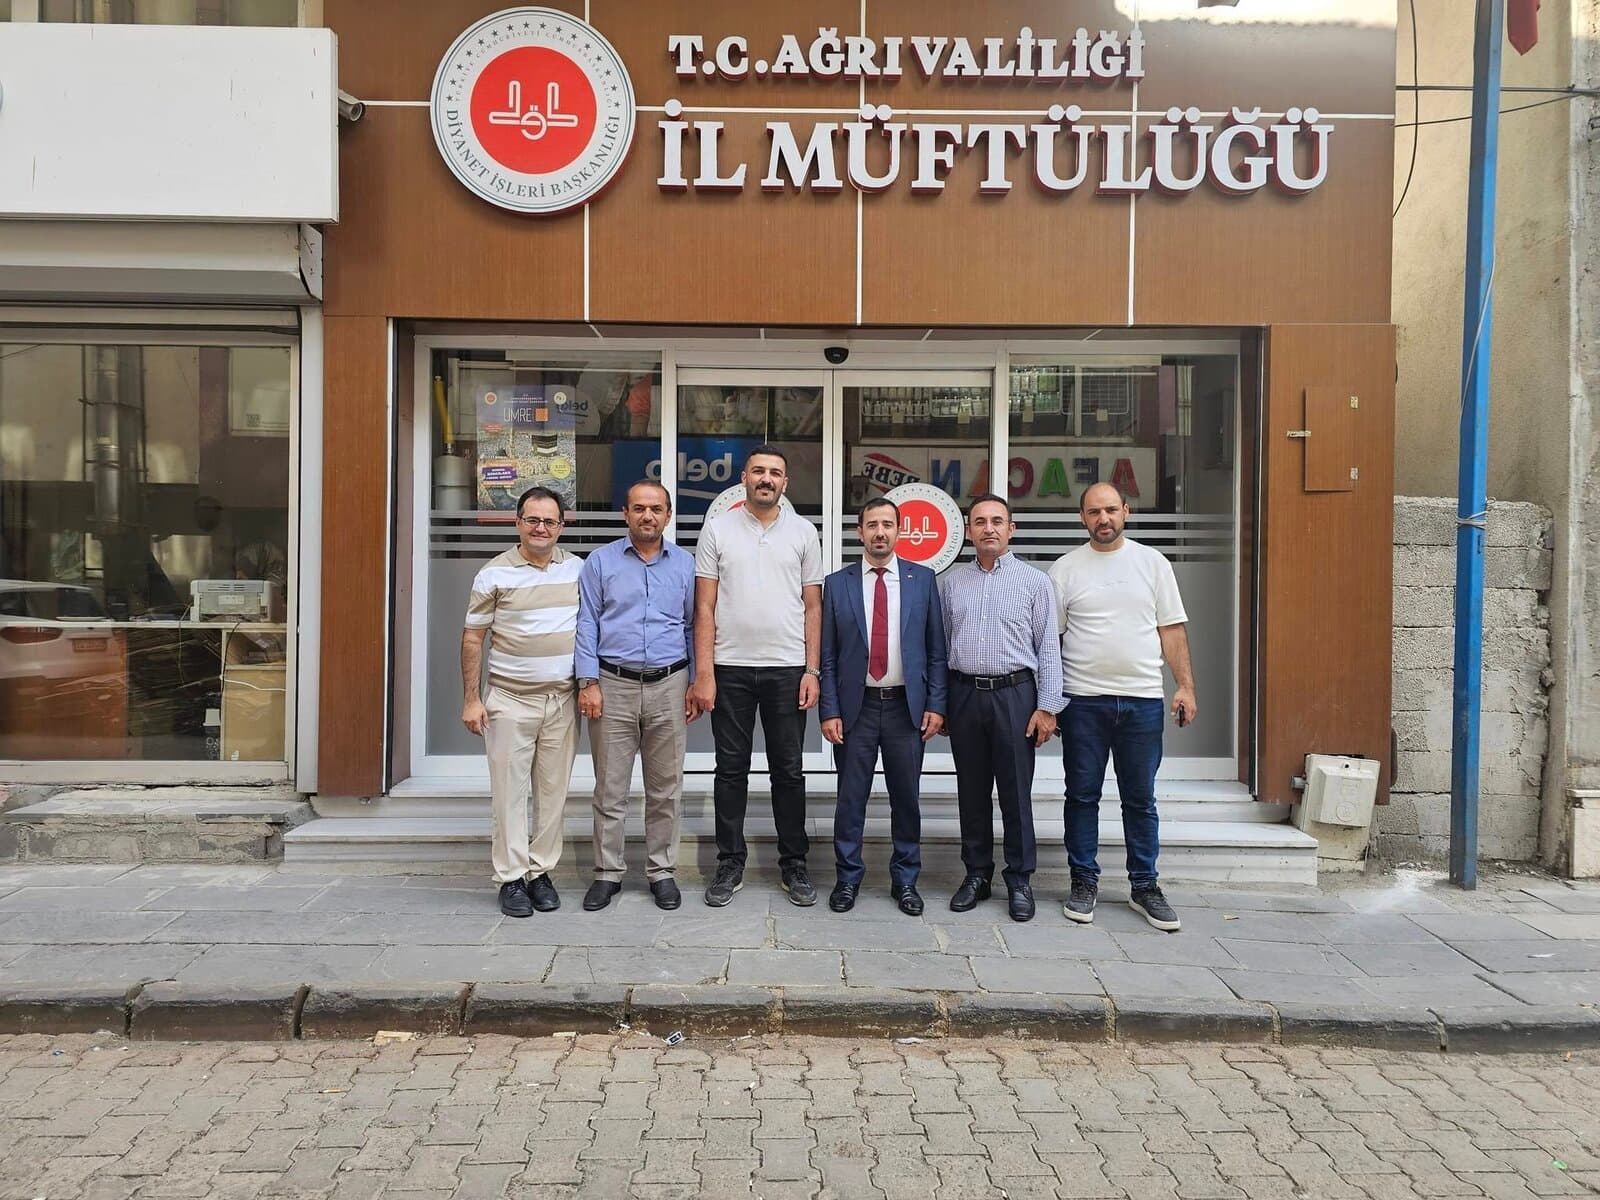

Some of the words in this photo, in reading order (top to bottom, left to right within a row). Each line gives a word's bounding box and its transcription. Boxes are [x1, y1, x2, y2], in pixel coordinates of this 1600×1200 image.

[910, 27, 1145, 79] VALİLİĞİ
[446, 109, 490, 179] DİYANET
[488, 172, 546, 198] İŞLERİ
[550, 115, 621, 195] BAŞKANLIĞI
[656, 99, 749, 190] İL
[760, 104, 1335, 194] MÜFTÜLÜĞÜ
[503, 407, 533, 422] UMRE
